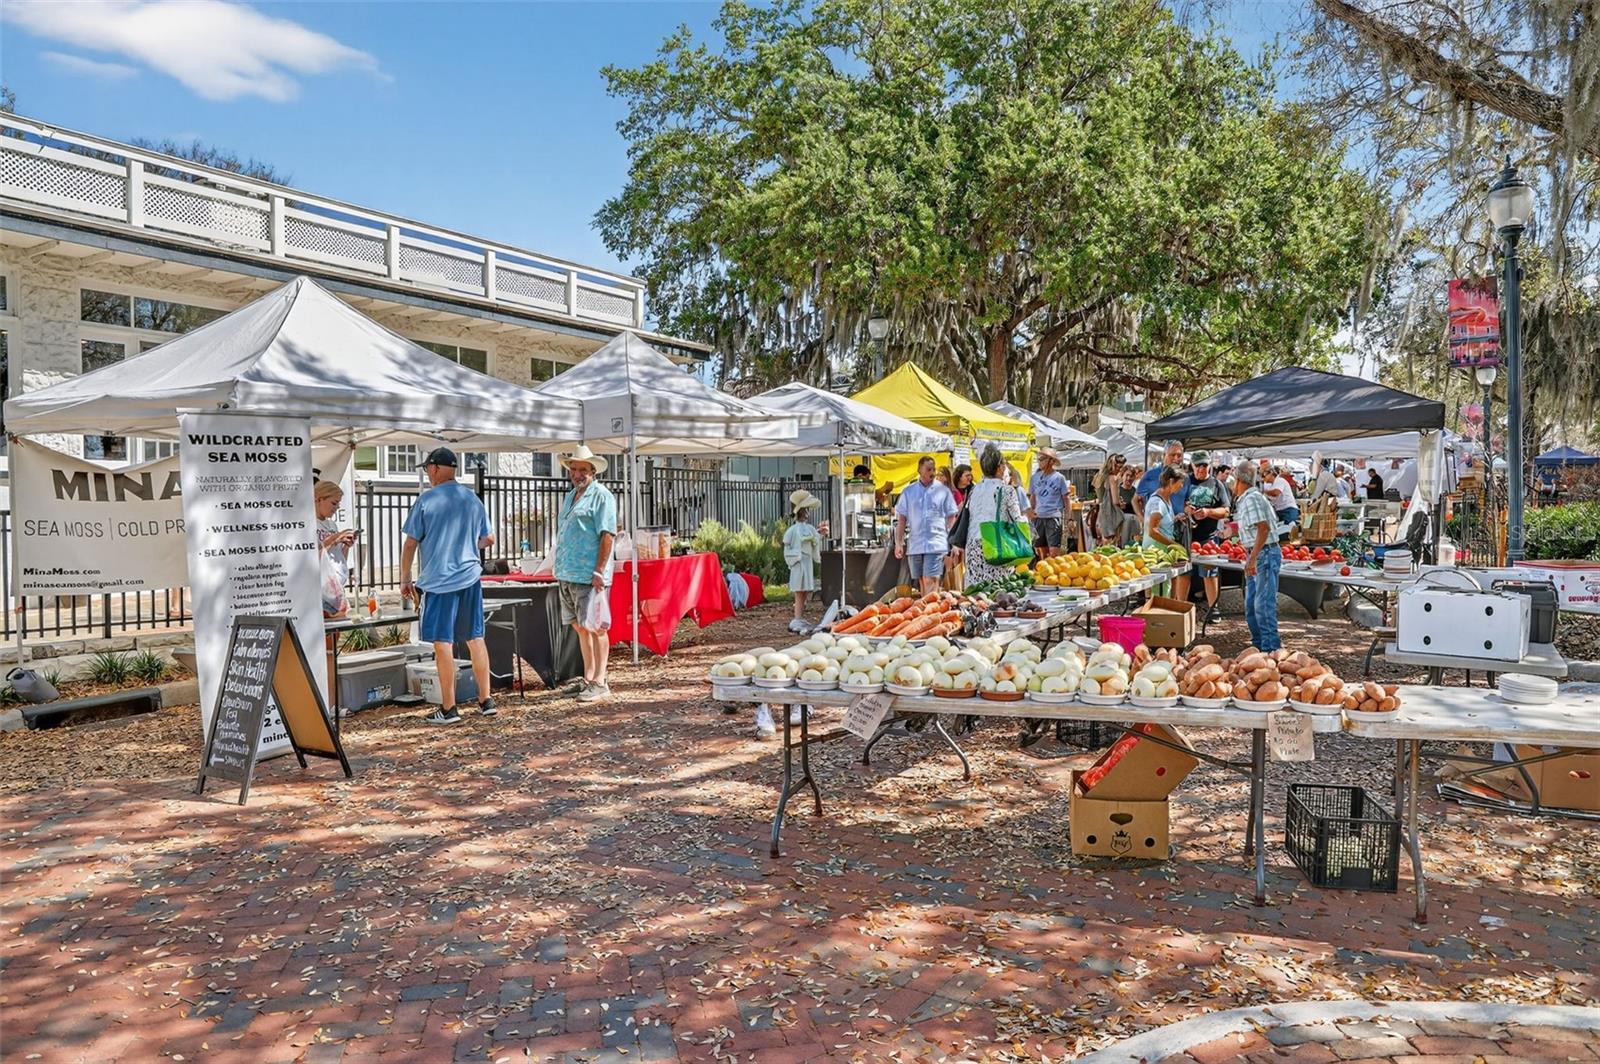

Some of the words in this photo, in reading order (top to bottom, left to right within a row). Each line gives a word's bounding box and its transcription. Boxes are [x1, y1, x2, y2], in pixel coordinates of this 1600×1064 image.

[188, 434, 303, 447] WILDCRAFTED
[208, 452, 240, 463] SEA
[245, 452, 287, 463] MOSS
[196, 475, 252, 484] NATURALLY
[199, 484, 226, 492] WITH
[228, 484, 271, 492] ORGANIC
[220, 501, 241, 510] SEA
[244, 501, 272, 509] MOSS
[24, 519, 60, 537] SEA
[64, 521, 103, 538] MOSS
[118, 520, 159, 537] COLD
[212, 523, 268, 534] WELLNESS
[270, 521, 306, 530] SHOTS
[204, 548, 226, 557] SEA
[228, 546, 257, 555] MOSS
[258, 542, 316, 553] LEMONADE
[23, 567, 101, 576] MinaMoss.com
[23, 578, 145, 590] minaseamoss@gmail.com
